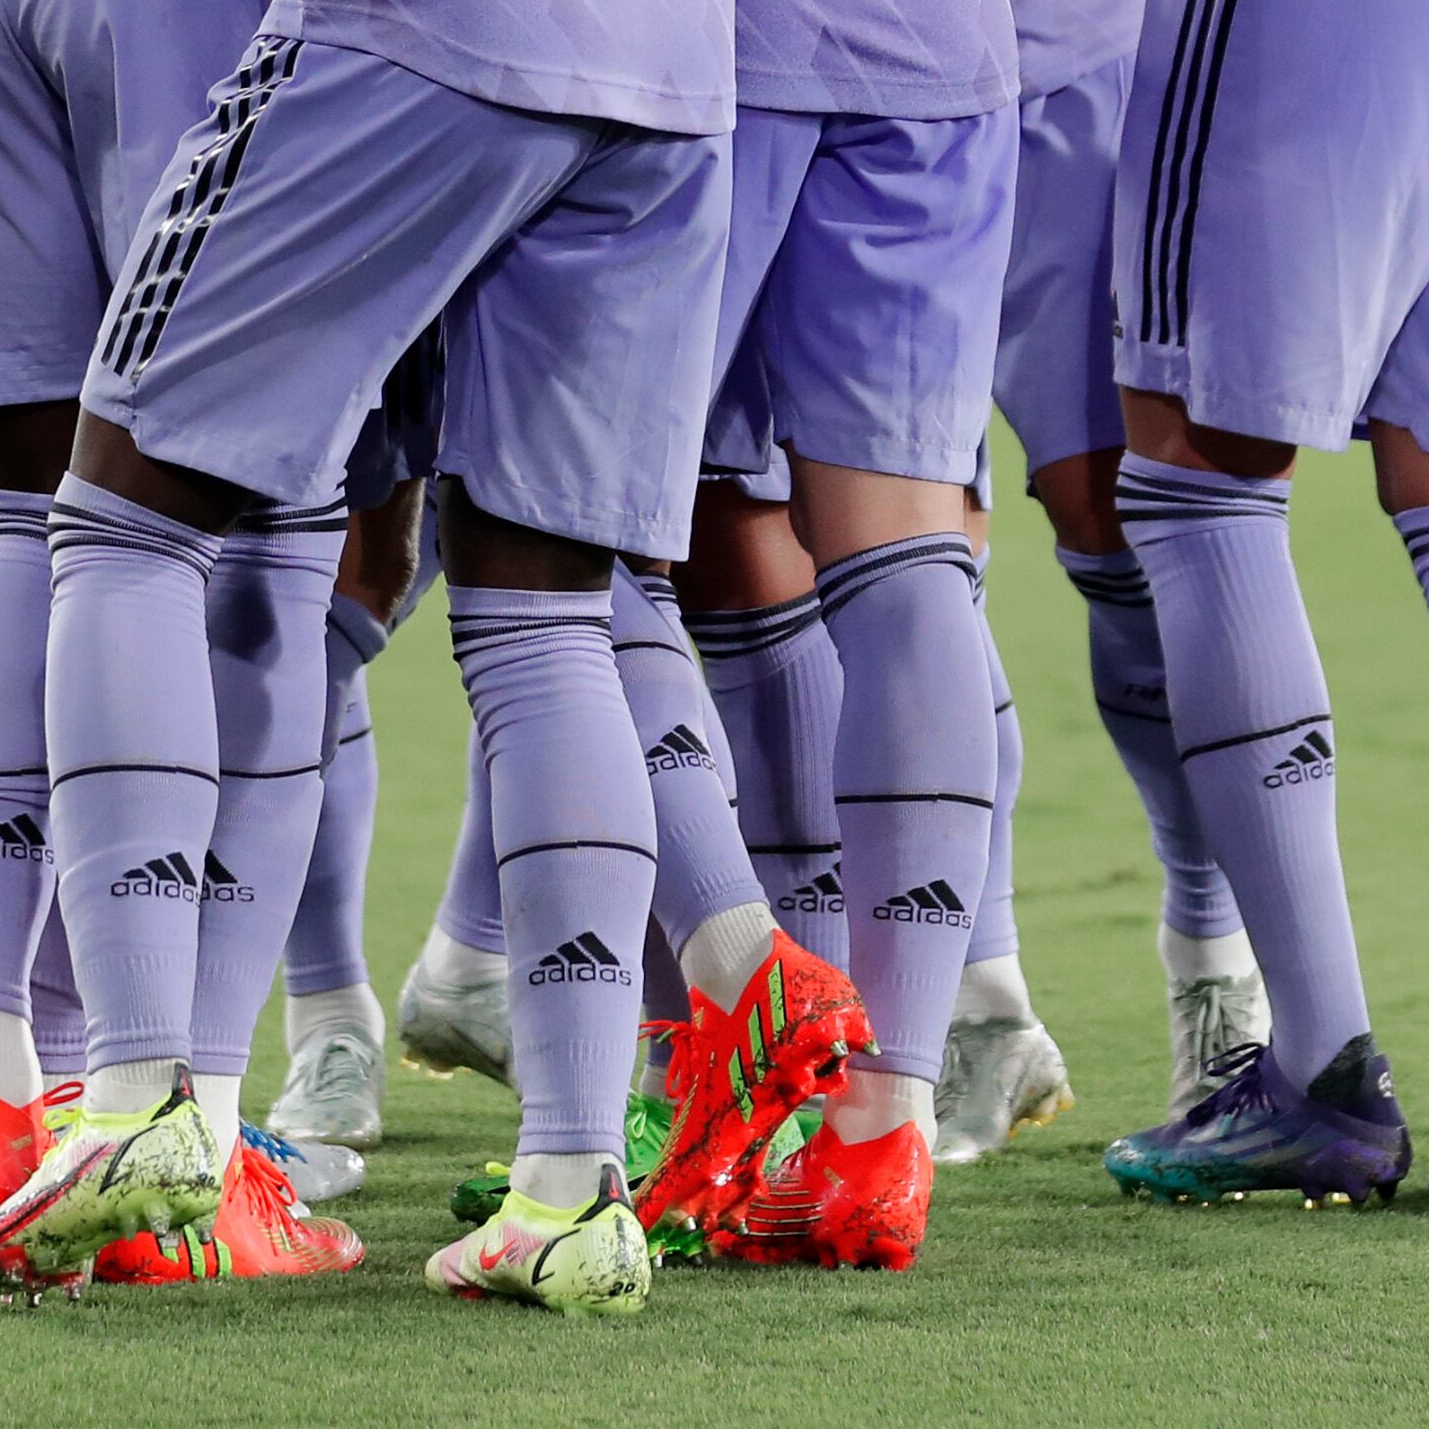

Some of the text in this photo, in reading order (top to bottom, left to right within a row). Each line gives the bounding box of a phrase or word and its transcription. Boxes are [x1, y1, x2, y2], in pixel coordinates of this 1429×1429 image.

[646, 751, 716, 776] adida
[1264, 759, 1333, 789] adida
[778, 892, 844, 914] adid
[873, 905, 972, 930] adidas
[528, 962, 632, 987] adidas
